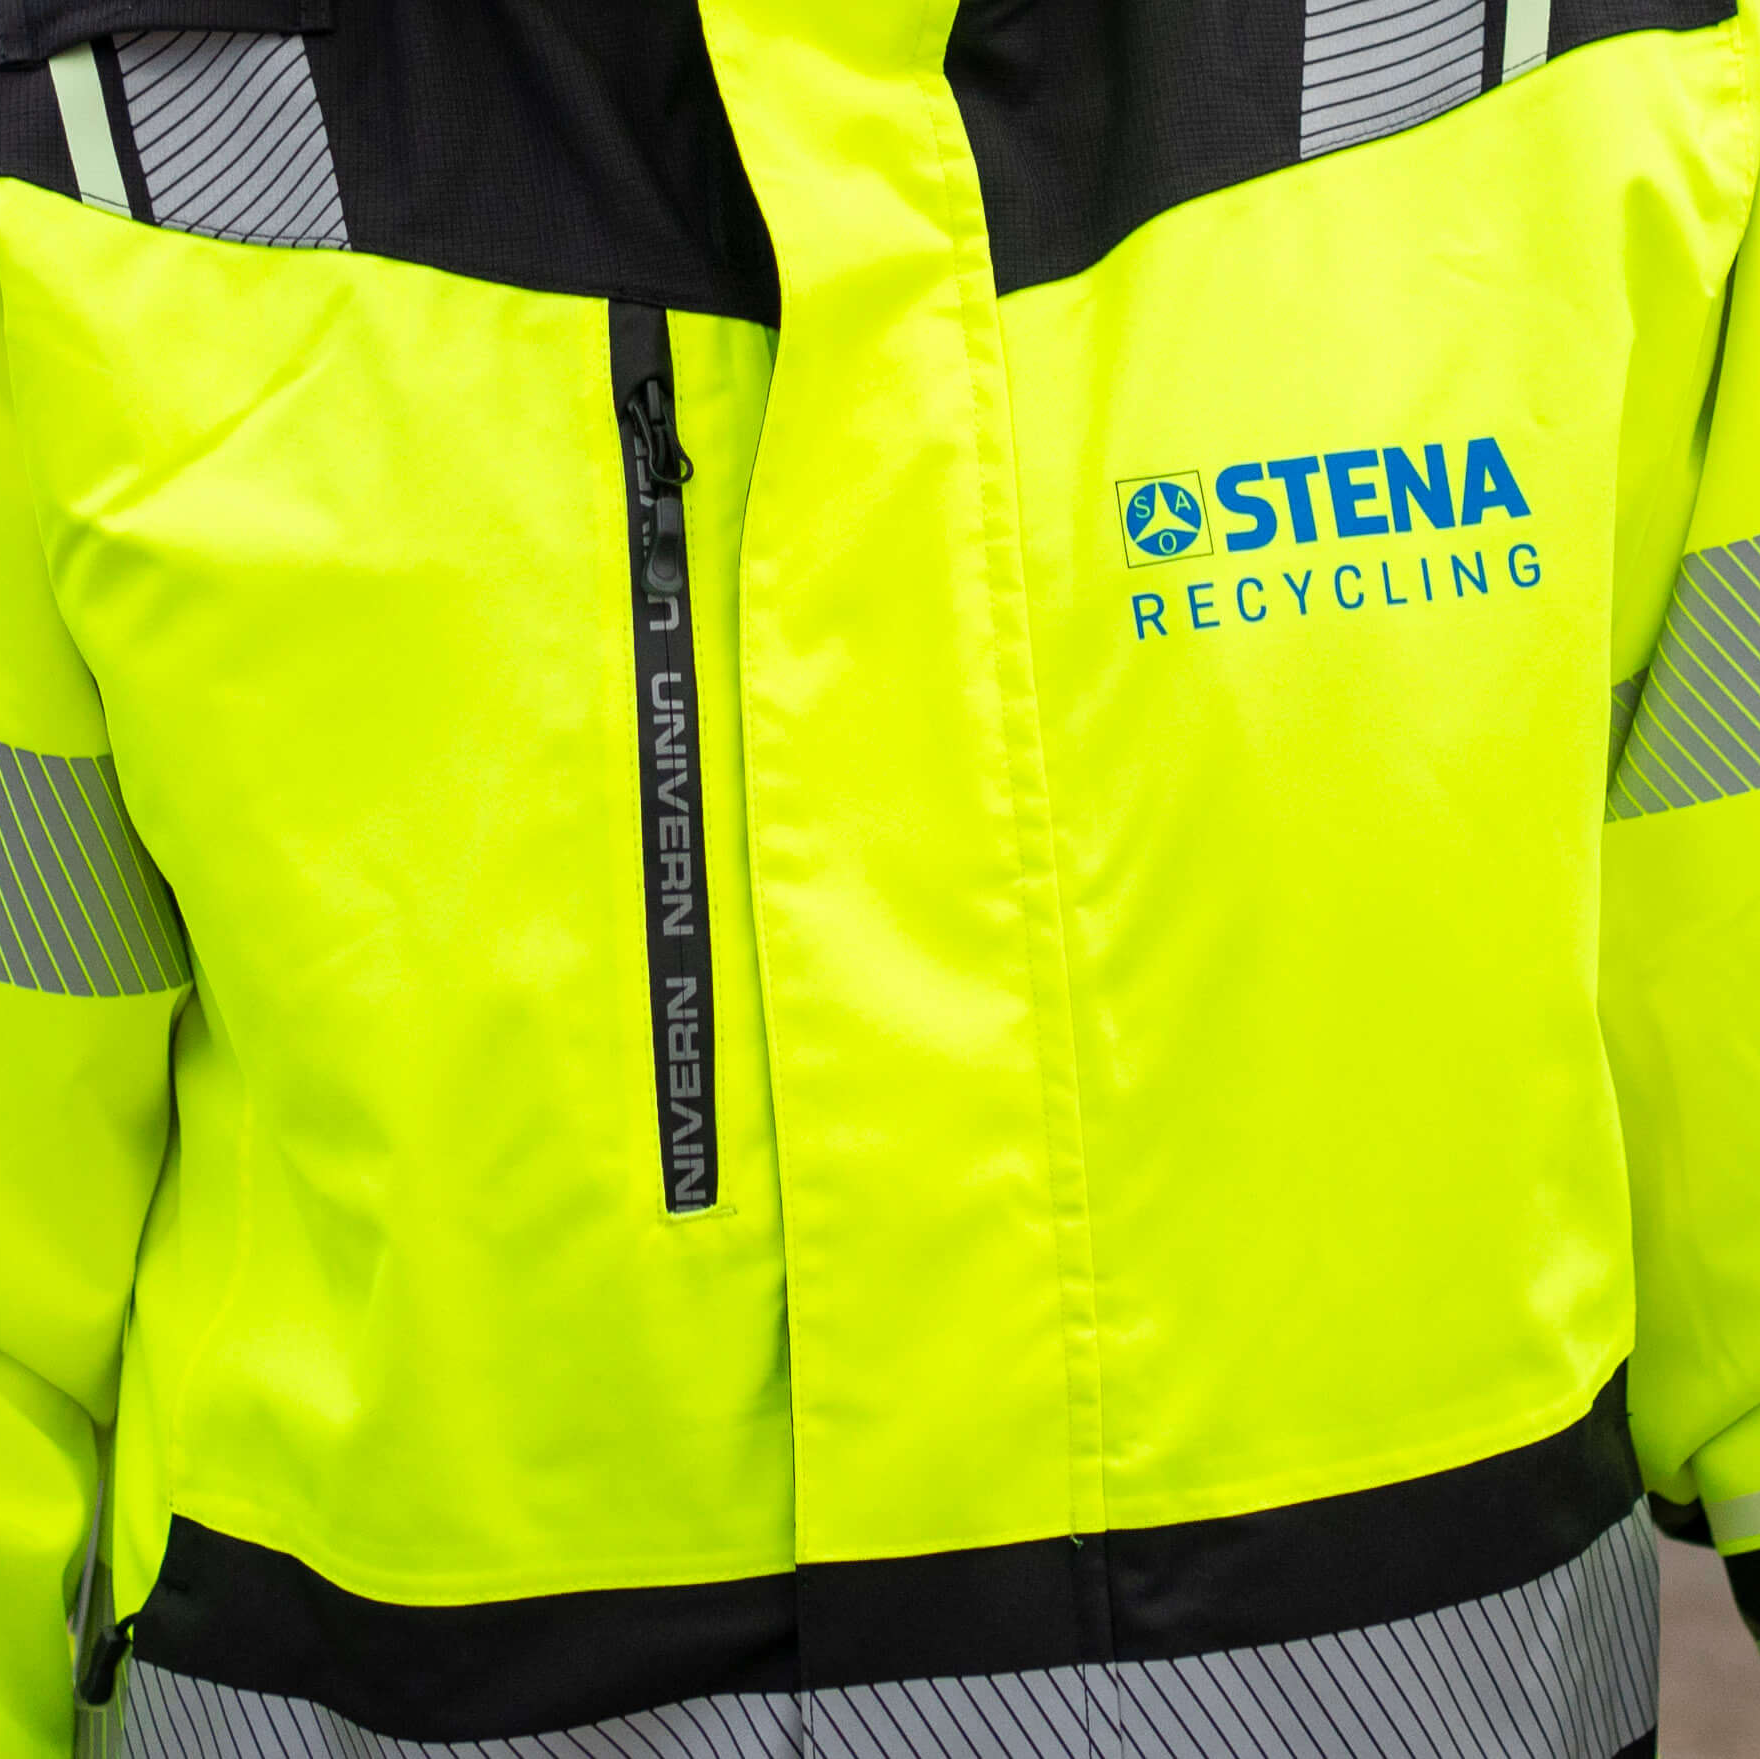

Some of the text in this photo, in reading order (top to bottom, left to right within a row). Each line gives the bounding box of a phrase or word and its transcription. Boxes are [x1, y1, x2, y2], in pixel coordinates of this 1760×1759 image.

[1215, 437, 1532, 553] STENA
[1132, 543, 1542, 641] RECYCLING
[649, 671, 695, 938] UNIVERN
